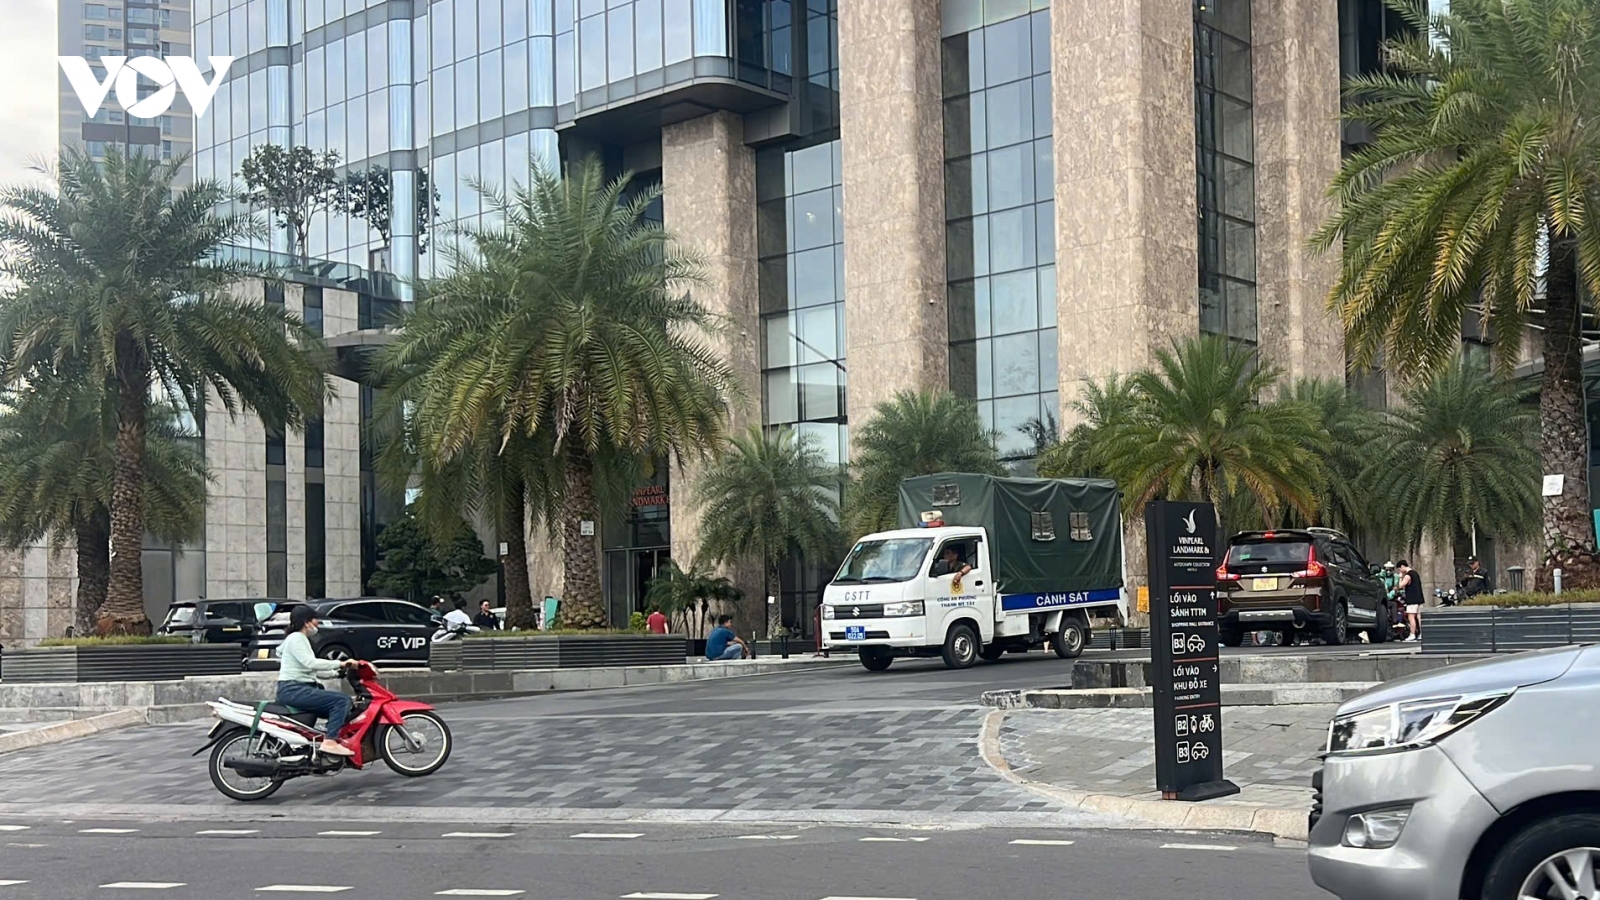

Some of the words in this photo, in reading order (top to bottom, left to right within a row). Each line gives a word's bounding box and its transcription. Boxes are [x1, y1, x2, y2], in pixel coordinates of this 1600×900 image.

[1178, 536, 1204, 545] VINPEARL
[1172, 545, 1204, 554] LANDMARK
[844, 590, 870, 602] CSTT
[1182, 592, 1197, 603] VÀO
[1190, 607, 1207, 617] TTTM
[376, 636, 399, 649] GF
[401, 637, 426, 650] VIP
[1174, 638, 1185, 649] B3
[1185, 665, 1200, 676] VÀO
[1173, 681, 1188, 691] KHU
[1199, 679, 1208, 688] XE
[1177, 720, 1187, 731] B2
[1178, 747, 1188, 758] B3
